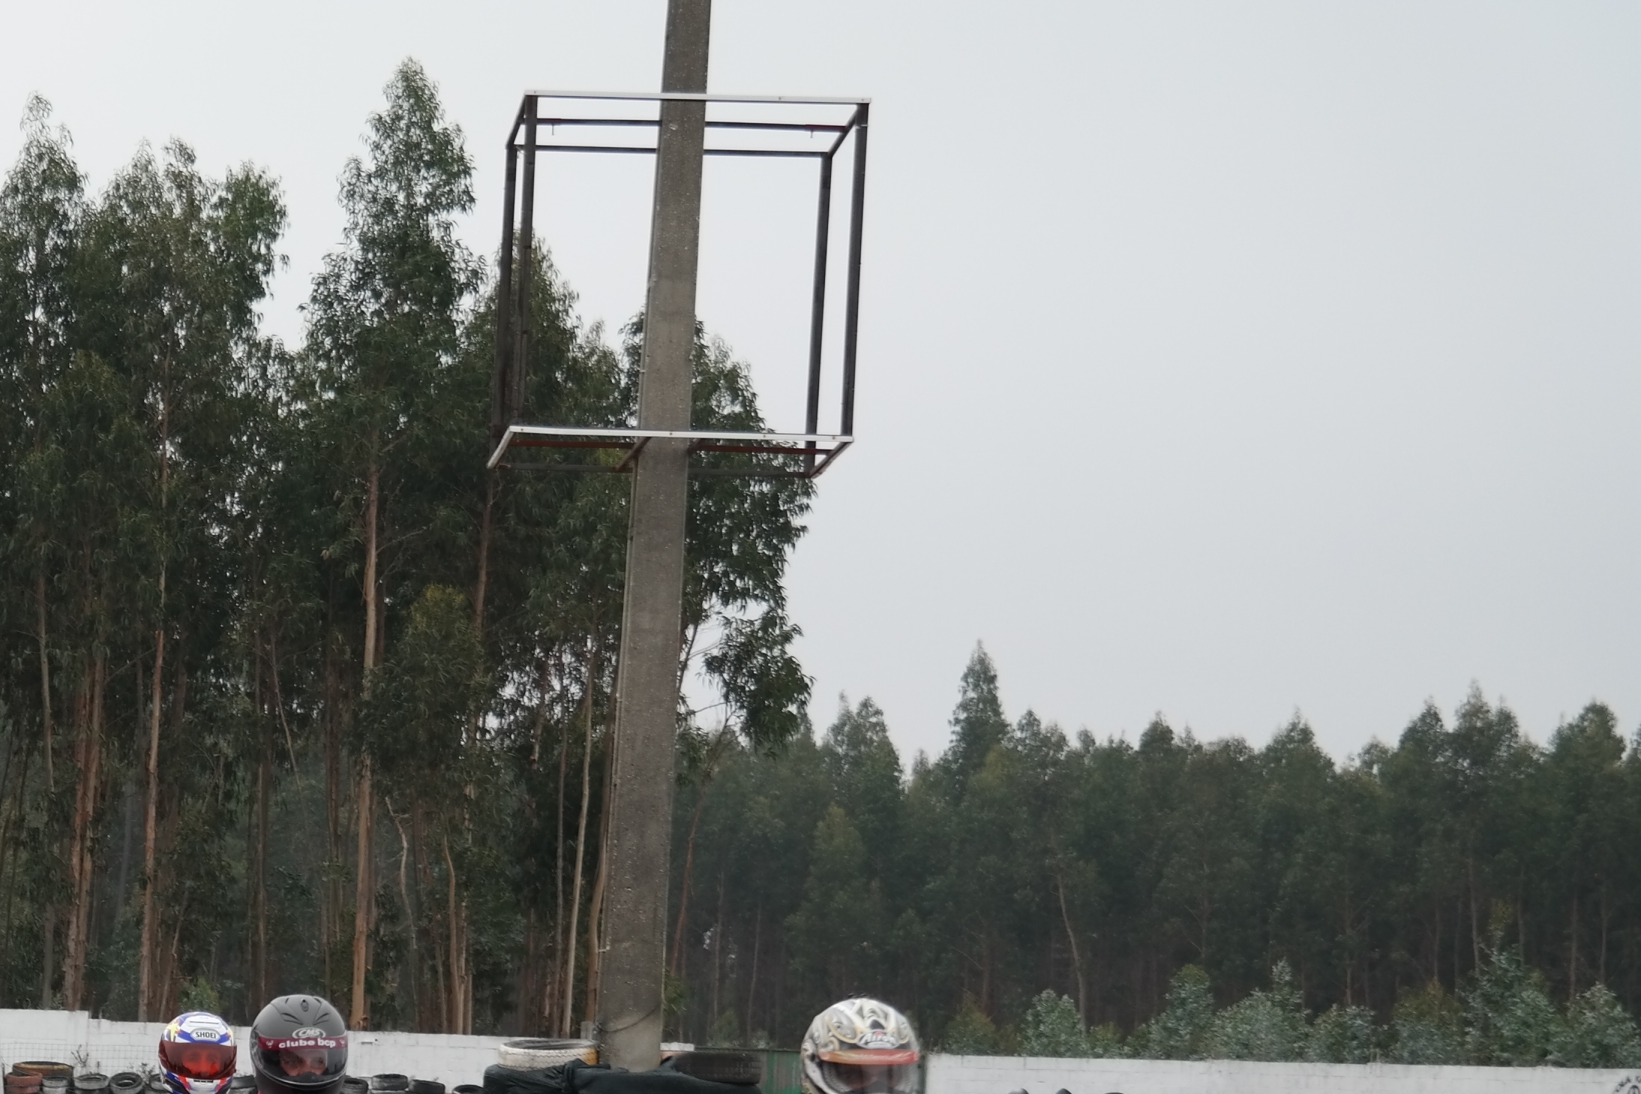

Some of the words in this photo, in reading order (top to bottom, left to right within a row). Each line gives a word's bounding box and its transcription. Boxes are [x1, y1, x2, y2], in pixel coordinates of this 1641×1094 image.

[195, 1031, 217, 1039] SHOEI
[298, 1029, 321, 1038] CMS
[278, 1039, 315, 1049] clube
[318, 1038, 337, 1048] bcp
